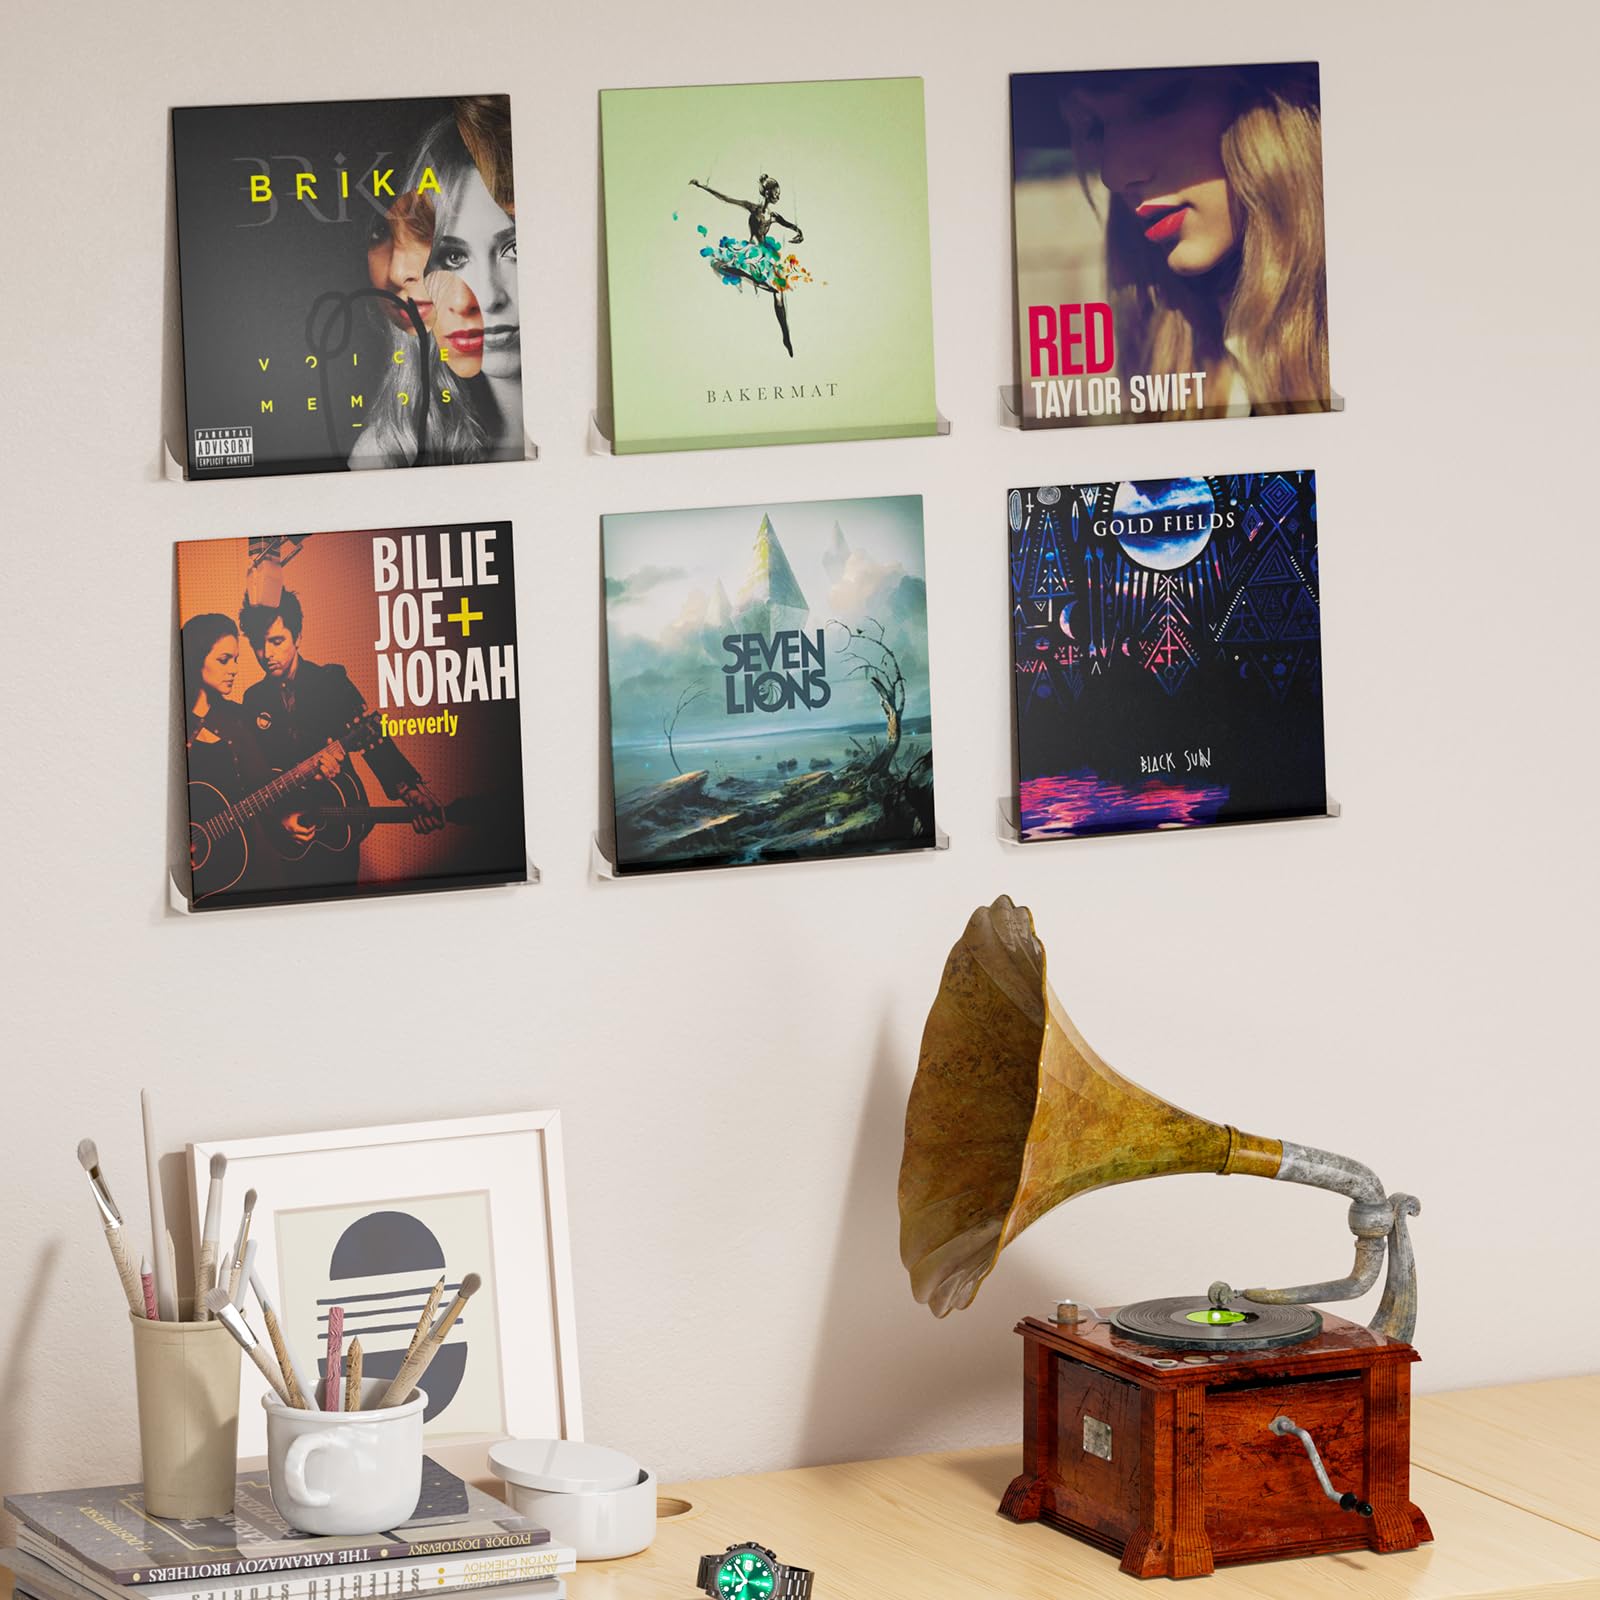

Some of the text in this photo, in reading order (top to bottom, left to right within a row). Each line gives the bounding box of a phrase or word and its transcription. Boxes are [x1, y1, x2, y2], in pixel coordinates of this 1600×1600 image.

[250, 167, 443, 202] BRIKA
[1028, 302, 1115, 378] RED
[259, 349, 449, 371] VOICE
[261, 391, 450, 413] MEMOS
[706, 383, 838, 403] BAKERMAT
[1030, 372, 1207, 419] TAYLOR SWIFT
[198, 429, 249, 439] PARENTAL
[198, 439, 250, 455] ADVISORY
[199, 455, 251, 467] EXPLICIT CONTENT
[1093, 512, 1235, 536] GOLD FIELDS
[372, 529, 499, 592] BILLIE
[722, 629, 826, 674] SEVEN
[377, 644, 516, 709] NORAH
[725, 669, 831, 714] LIONS
[380, 709, 458, 737] foreverly
[1140, 752, 1176, 773] BLACK
[149, 1534, 531, 1582] FYODOR DOSTOEVSKY THE KARAMAZOV BROTHERS
[463, 1558, 517, 1572] CHEKHOV
[520, 1553, 558, 1566] ANTON
[463, 1568, 517, 1583] CHEKHOV
[519, 1564, 558, 1577] ANTON
